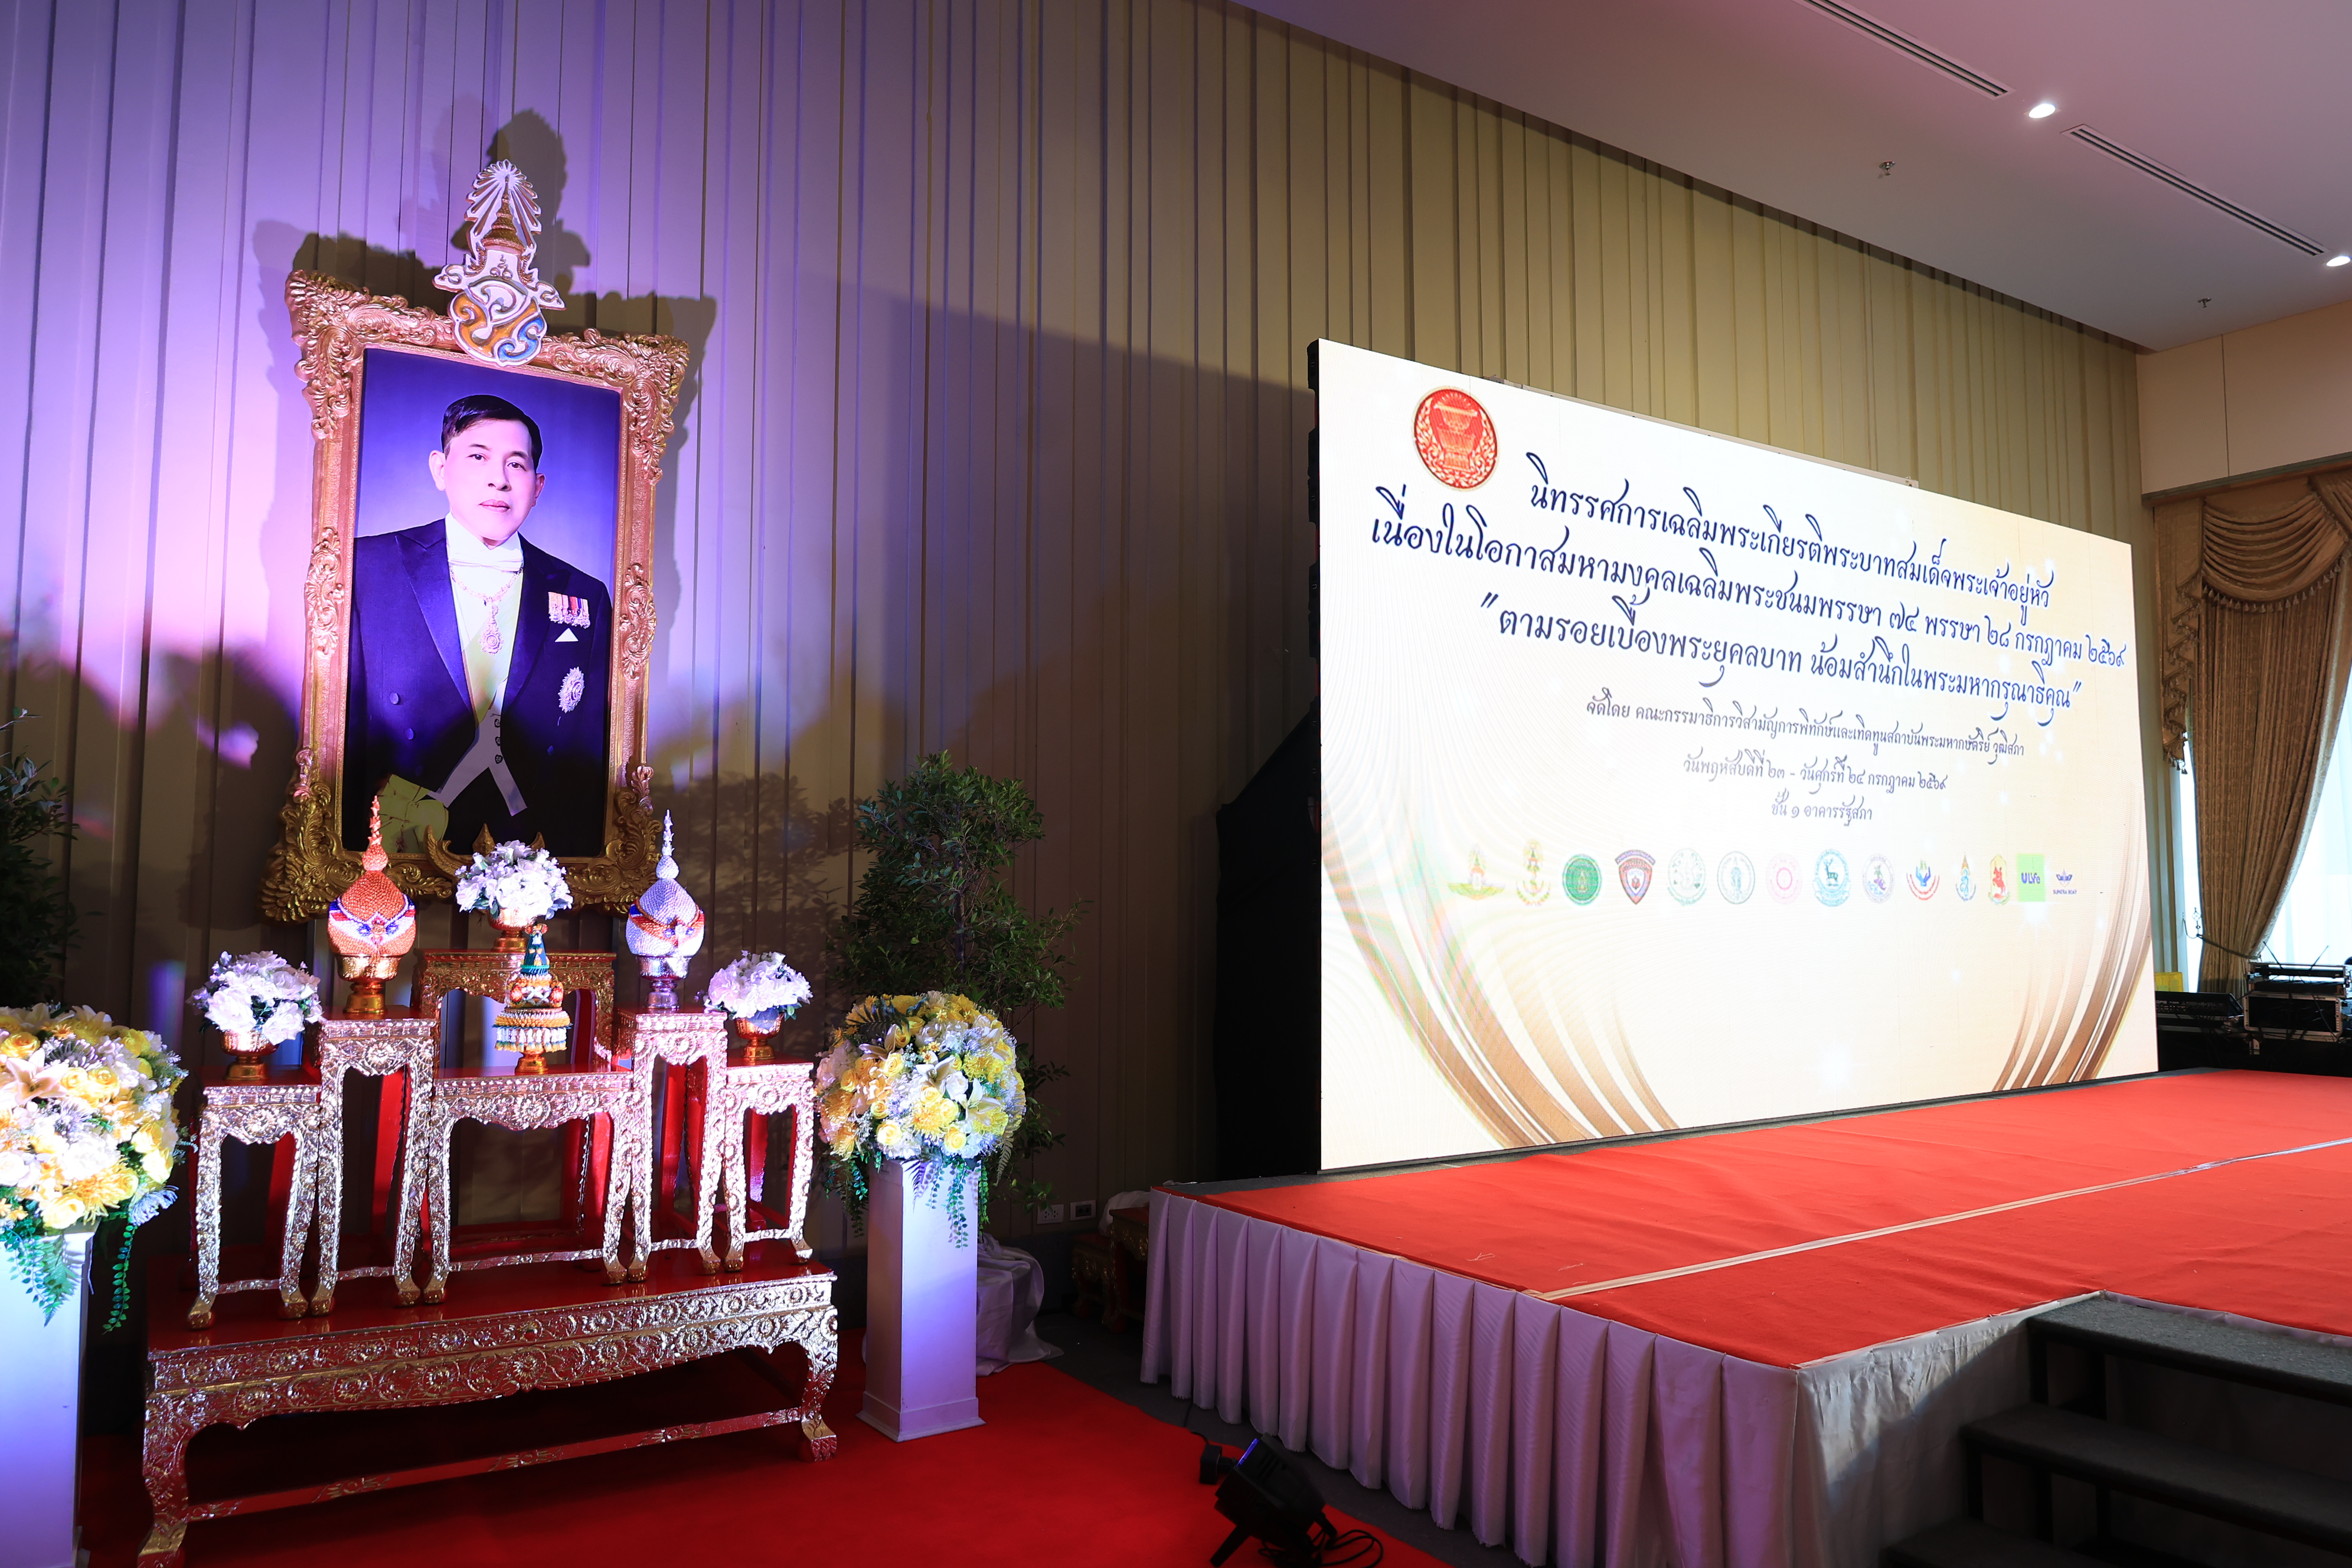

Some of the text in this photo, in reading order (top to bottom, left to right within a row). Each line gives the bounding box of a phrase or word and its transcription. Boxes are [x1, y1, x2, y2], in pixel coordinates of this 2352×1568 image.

[1371, 484, 2125, 667] เนื่องในโอกาสมหามงคลเฉลิมพระชนมพรรษา ๗๔ พรรษา ๒๘ กรกฎาคม ๒๕๖๙
[1526, 452, 2054, 626] นิทรรศการเฉลิมพระเกียรติพระบาทสมเด็จพระเจ้าอยู่หัว
[1587, 687, 2025, 765] จัดโดย คณะกรรมาธิการวิสามัญการพิทักษ์และเทิดทูนสถาบันพระมหากษัตริย์ วุฒิสภา
[1683, 746, 1765, 782] วันพฤหัสบดีที่
[1765, 759, 1785, 779] ๒๓
[1847, 765, 1866, 786] ๒๔
[1868, 773, 1916, 794] กรกฎาคม
[1917, 771, 1949, 791] ๒๕๖๙
[1771, 788, 1873, 827] ชั้น ๑ อาคารรัฐสภา
